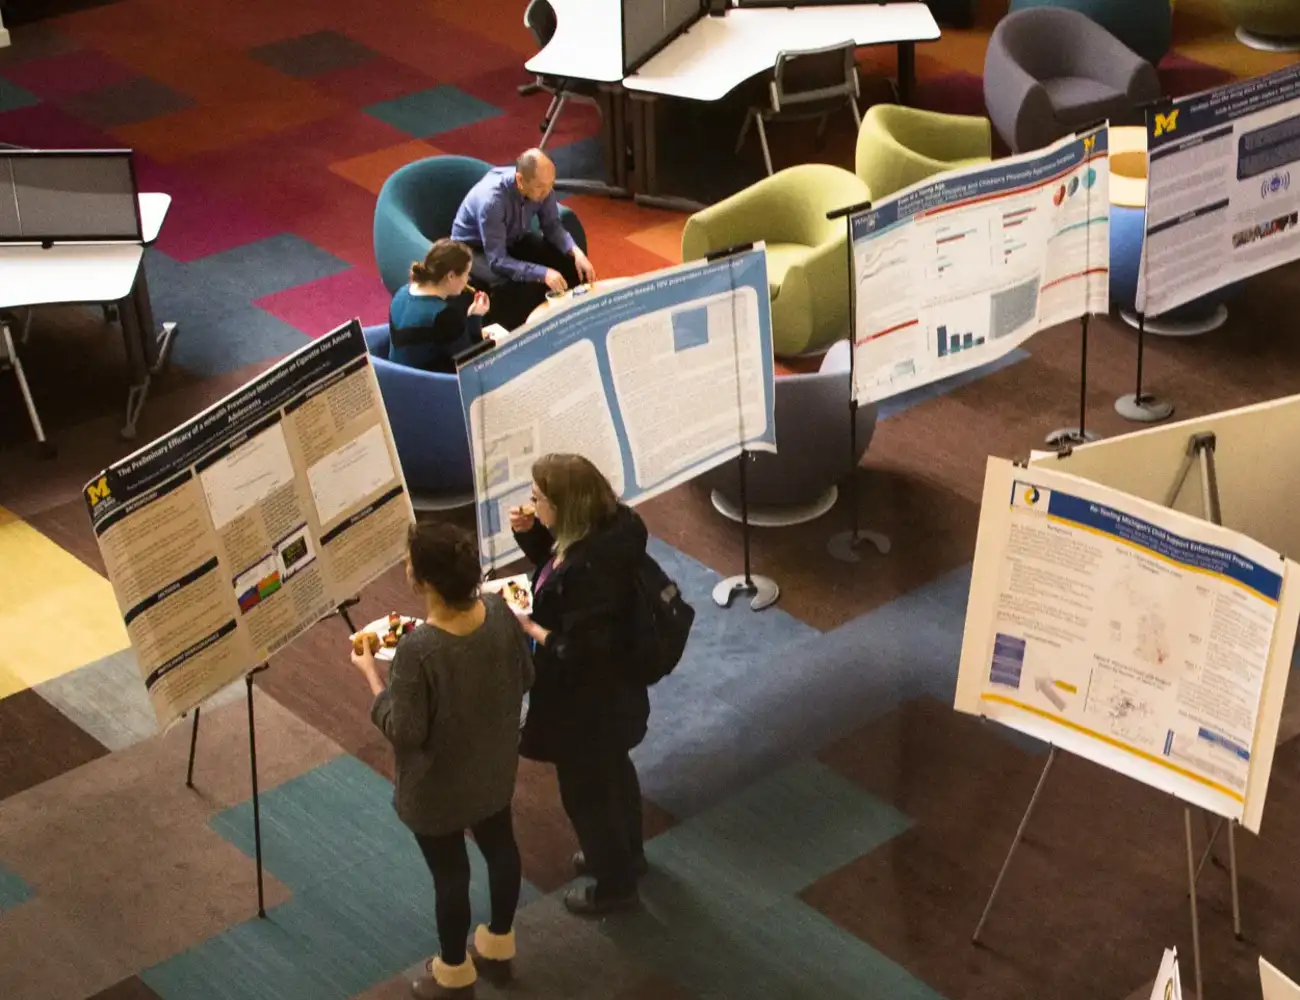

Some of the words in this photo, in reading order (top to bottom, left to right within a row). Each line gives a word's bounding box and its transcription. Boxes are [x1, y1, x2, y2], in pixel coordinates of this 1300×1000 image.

[1154, 108, 1180, 137] M
[117, 464, 132, 478] The
[132, 444, 168, 470] Preliminary
[168, 430, 192, 451] Efficacy
[204, 408, 228, 430] mHealth
[227, 389, 257, 412] Preventive
[256, 369, 290, 394] Intervention
[296, 348, 320, 367] Cigarette
[320, 342, 332, 352] Use
[332, 330, 352, 346] Among
[228, 399, 262, 422] Adolescents
[87, 476, 111, 506] M
[1121, 515, 1152, 534] Michigan's
[1152, 527, 1166, 540] Child
[1166, 532, 1190, 549] Support
[1190, 543, 1232, 560] Enforcement
[1232, 555, 1254, 572] Program
